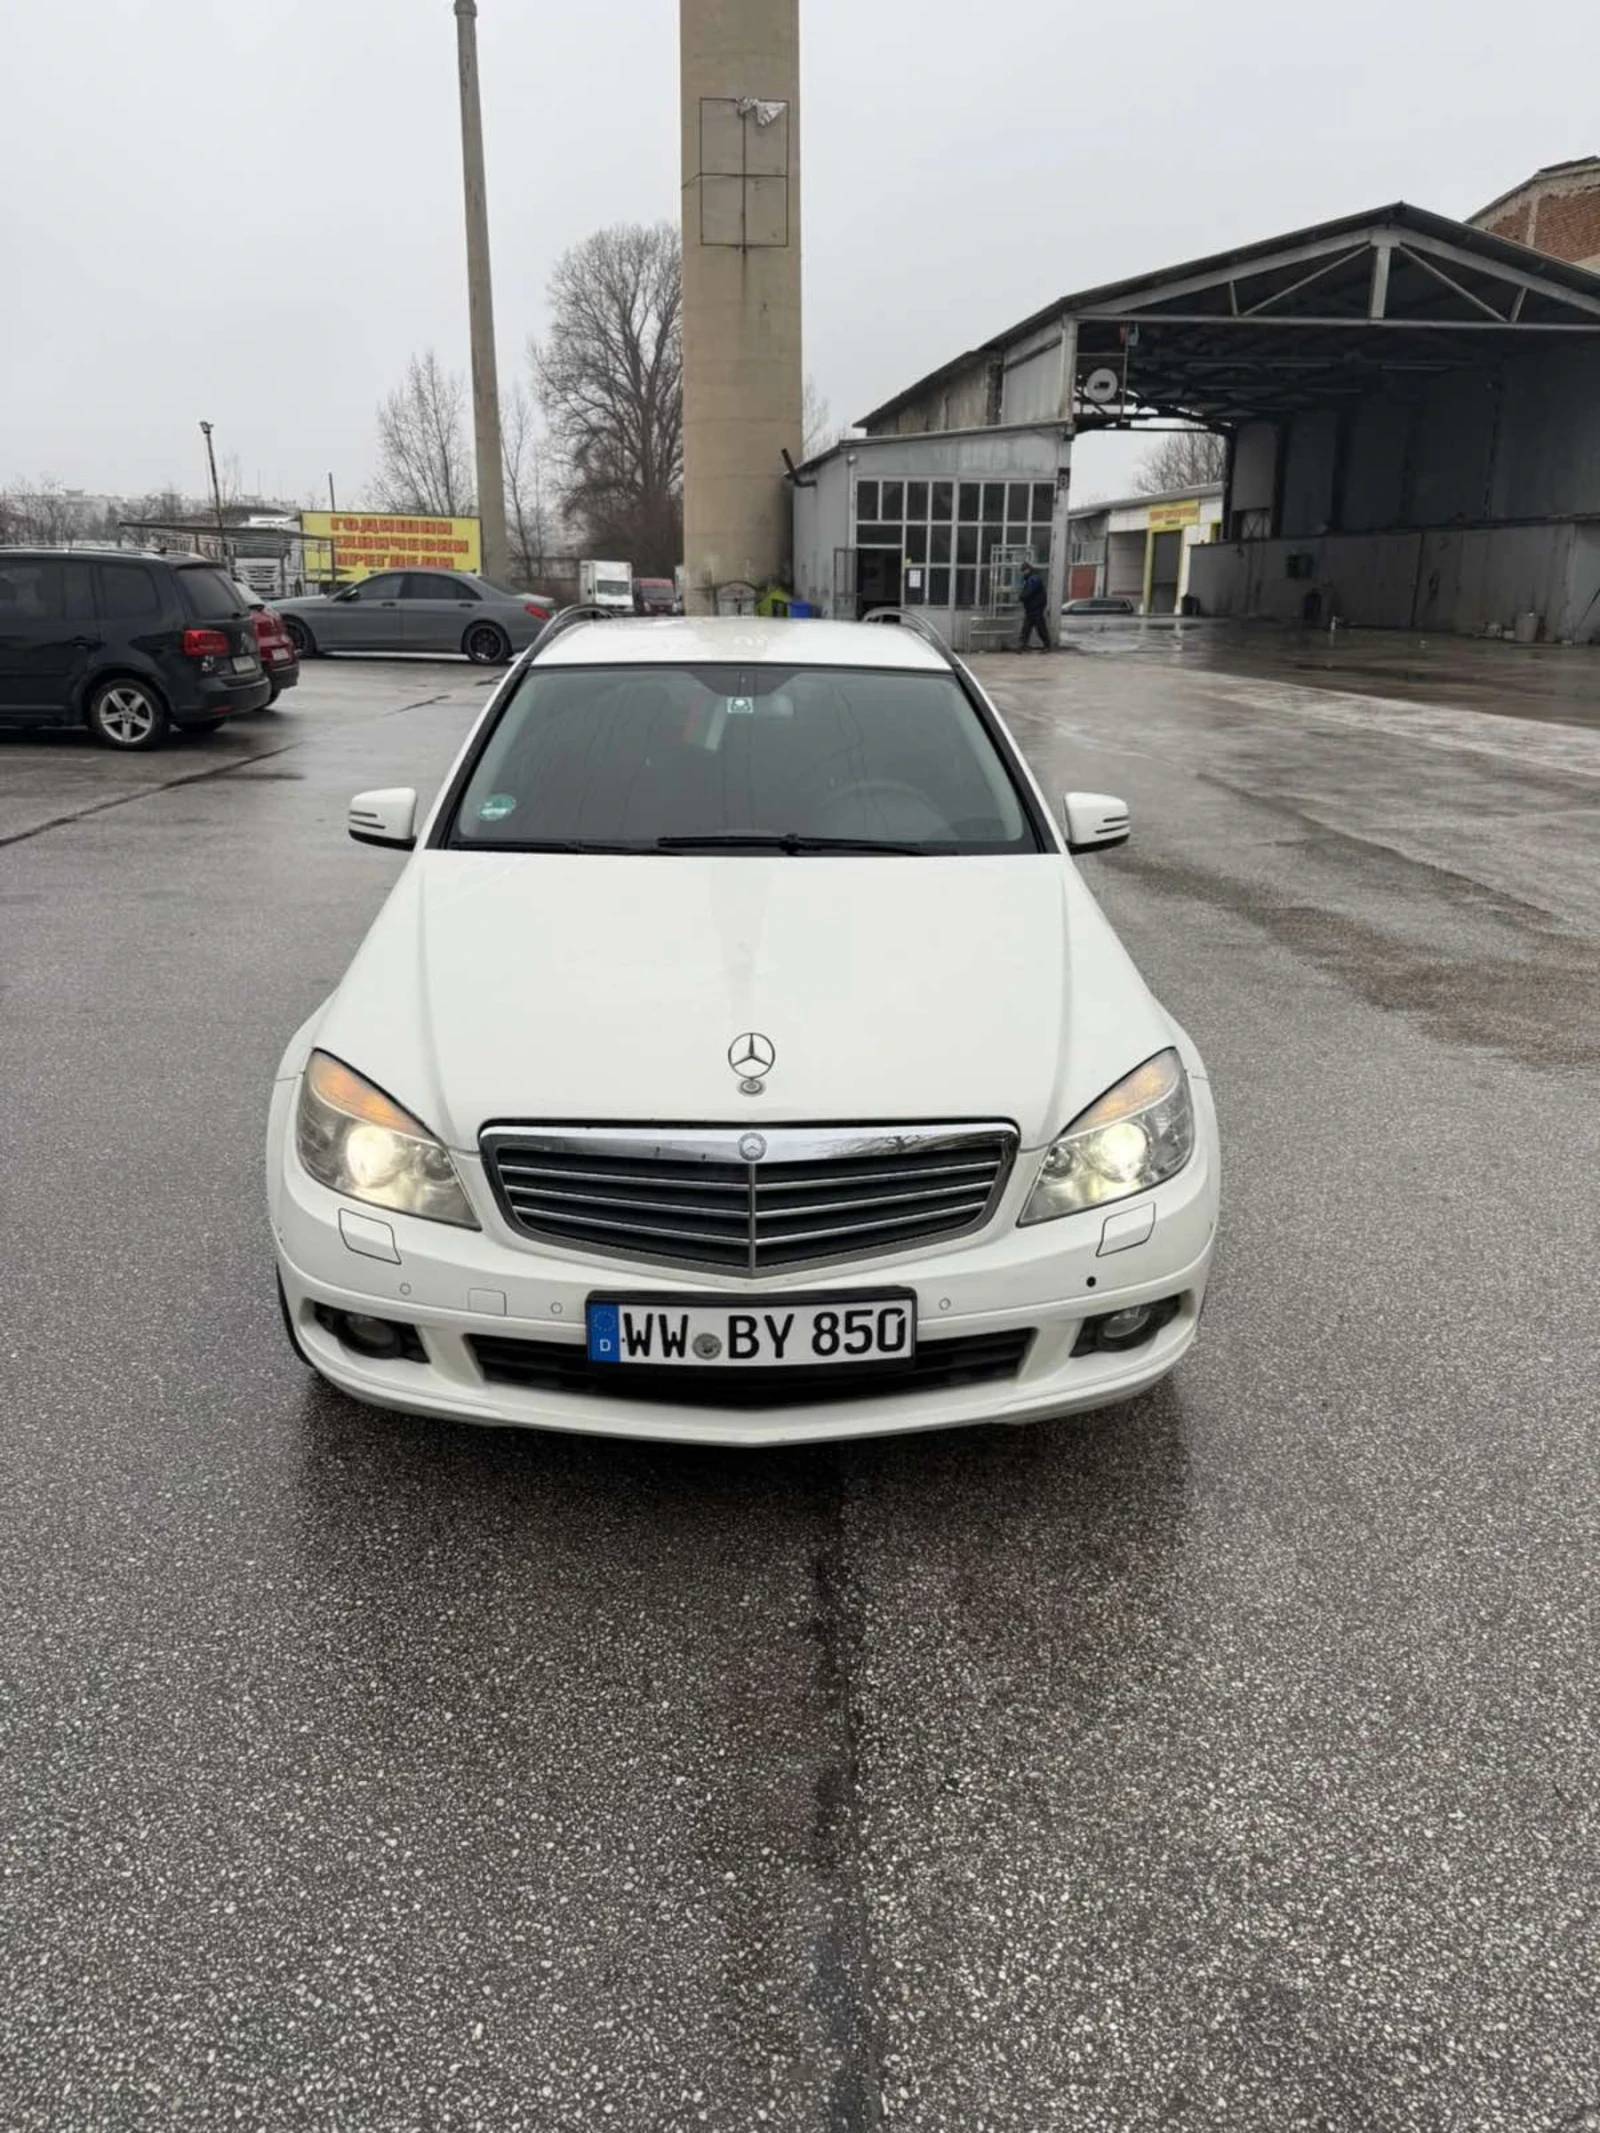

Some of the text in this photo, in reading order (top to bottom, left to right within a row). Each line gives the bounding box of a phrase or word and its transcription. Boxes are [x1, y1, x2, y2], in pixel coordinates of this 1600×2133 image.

[331, 517, 453, 535] ГОДИШНИ
[335, 535, 469, 553] ХНИЧЕСКИ
[623, 1308, 906, 1360] WW BY 850
[600, 1339, 611, 1351] D
